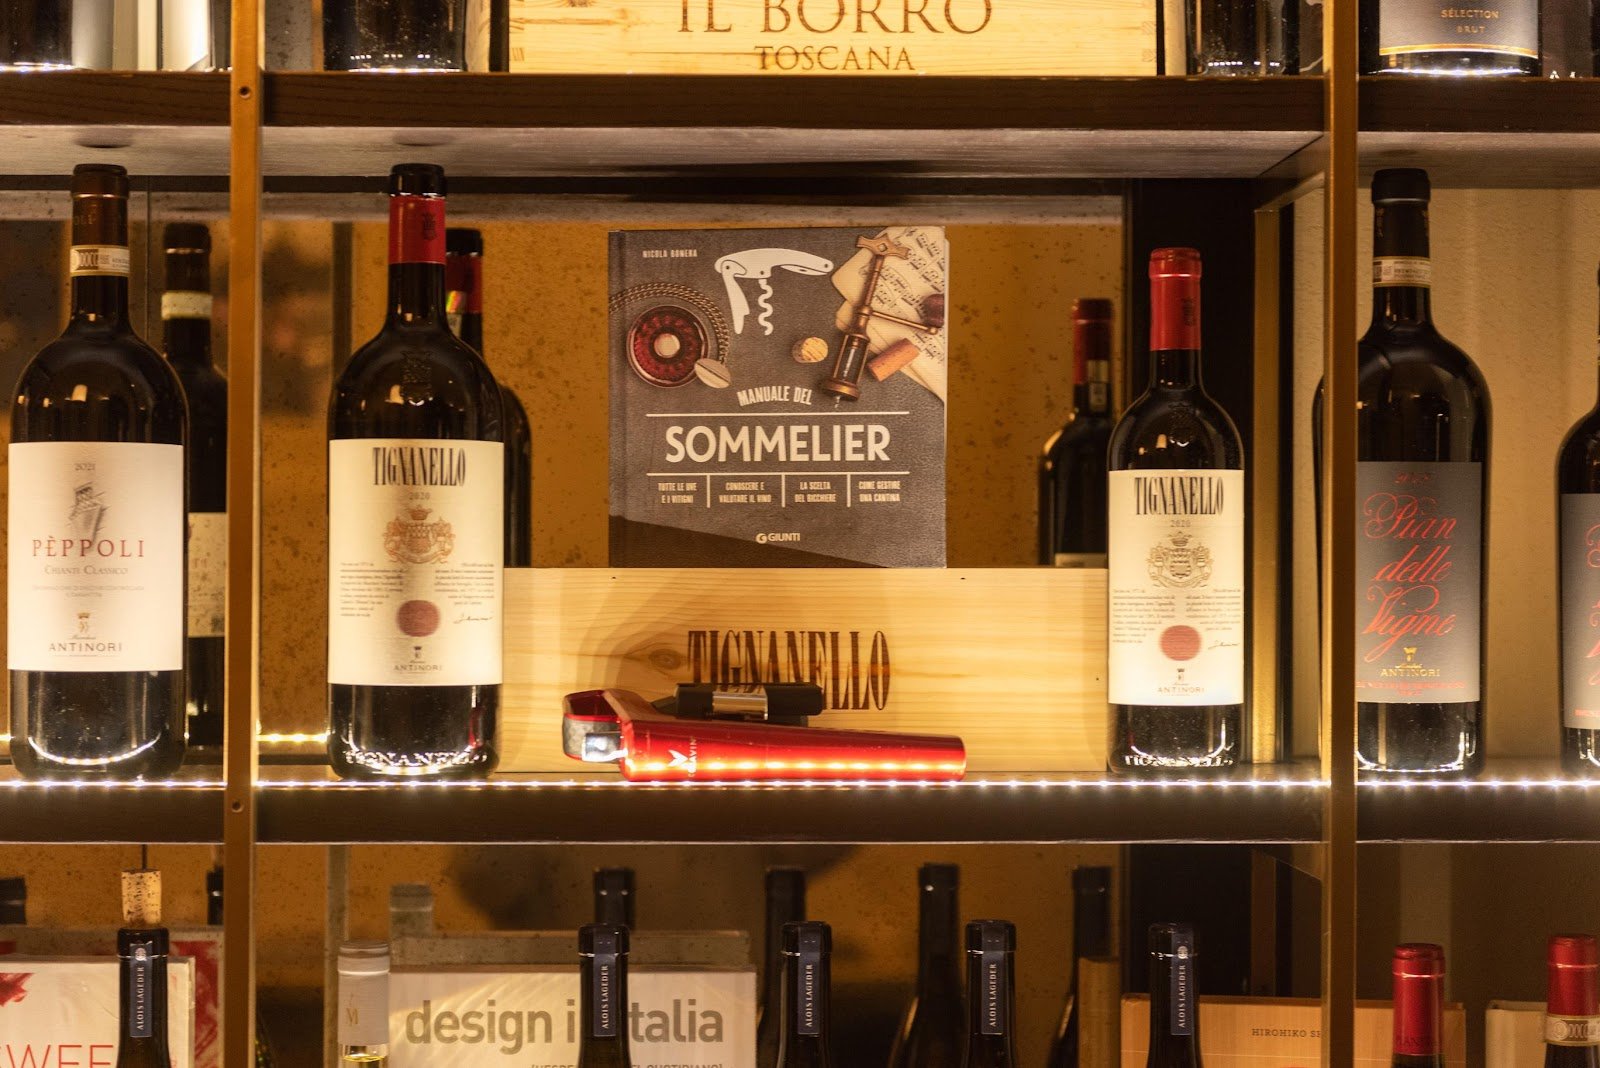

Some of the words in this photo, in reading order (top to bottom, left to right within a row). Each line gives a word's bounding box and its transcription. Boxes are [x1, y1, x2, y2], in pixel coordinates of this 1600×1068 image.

[678, 0, 733, 33] IL
[760, 0, 993, 34] BORRO
[1440, 7, 1499, 19] SÉLECTION
[1456, 25, 1485, 33] BRUT
[754, 45, 915, 70] TOSCANA
[642, 249, 668, 258] NICOLA
[736, 385, 790, 407] MANUALE
[793, 388, 813, 406] DEL
[665, 424, 891, 463] SOMMELIER
[372, 446, 466, 486] TIGNANELLO
[658, 482, 676, 491] TUTTE
[677, 482, 685, 491] LE
[725, 481, 759, 491] CONOSCERE
[760, 481, 765, 491] E
[799, 481, 808, 490] LA
[809, 481, 831, 490] SCELTA
[858, 480, 875, 490] COME
[876, 480, 901, 490] GESTIRE
[859, 493, 872, 502] UNA
[873, 493, 901, 502] CANTINA
[1134, 476, 1224, 515] TIGNANELLO
[661, 494, 666, 503] E
[719, 494, 748, 503] VALUTARE
[749, 494, 756, 503] IL
[794, 493, 805, 503] DEL
[1363, 492, 1457, 539] Pian
[32, 535, 144, 557] PÈPPOLI
[768, 532, 801, 542] GIUNTI
[1372, 544, 1452, 583] delle
[1361, 584, 1457, 664] Vigne
[49, 642, 122, 652] ANTINORI
[687, 629, 890, 711] TIGNANELLO
[1381, 668, 1441, 677] ANTINORI
[136, 966, 145, 1004] LAGEDER
[601, 965, 609, 1003] LAGEDER
[805, 964, 814, 1001] LAGEDER
[988, 963, 997, 1001] LAGEDER
[1178, 964, 1187, 1002] LAGEDER
[136, 1005, 145, 1030] ALOIS
[601, 1003, 609, 1029] ALOIS
[805, 1001, 814, 1027] ALOIS
[988, 1001, 997, 1027] ALOIS
[1178, 1003, 1187, 1028] ALOIS
[405, 1000, 553, 1055] design
[628, 999, 723, 1043] talia
[1251, 1028, 1307, 1038] HIROHIKO
[0, 1044, 114, 1068] WEE
